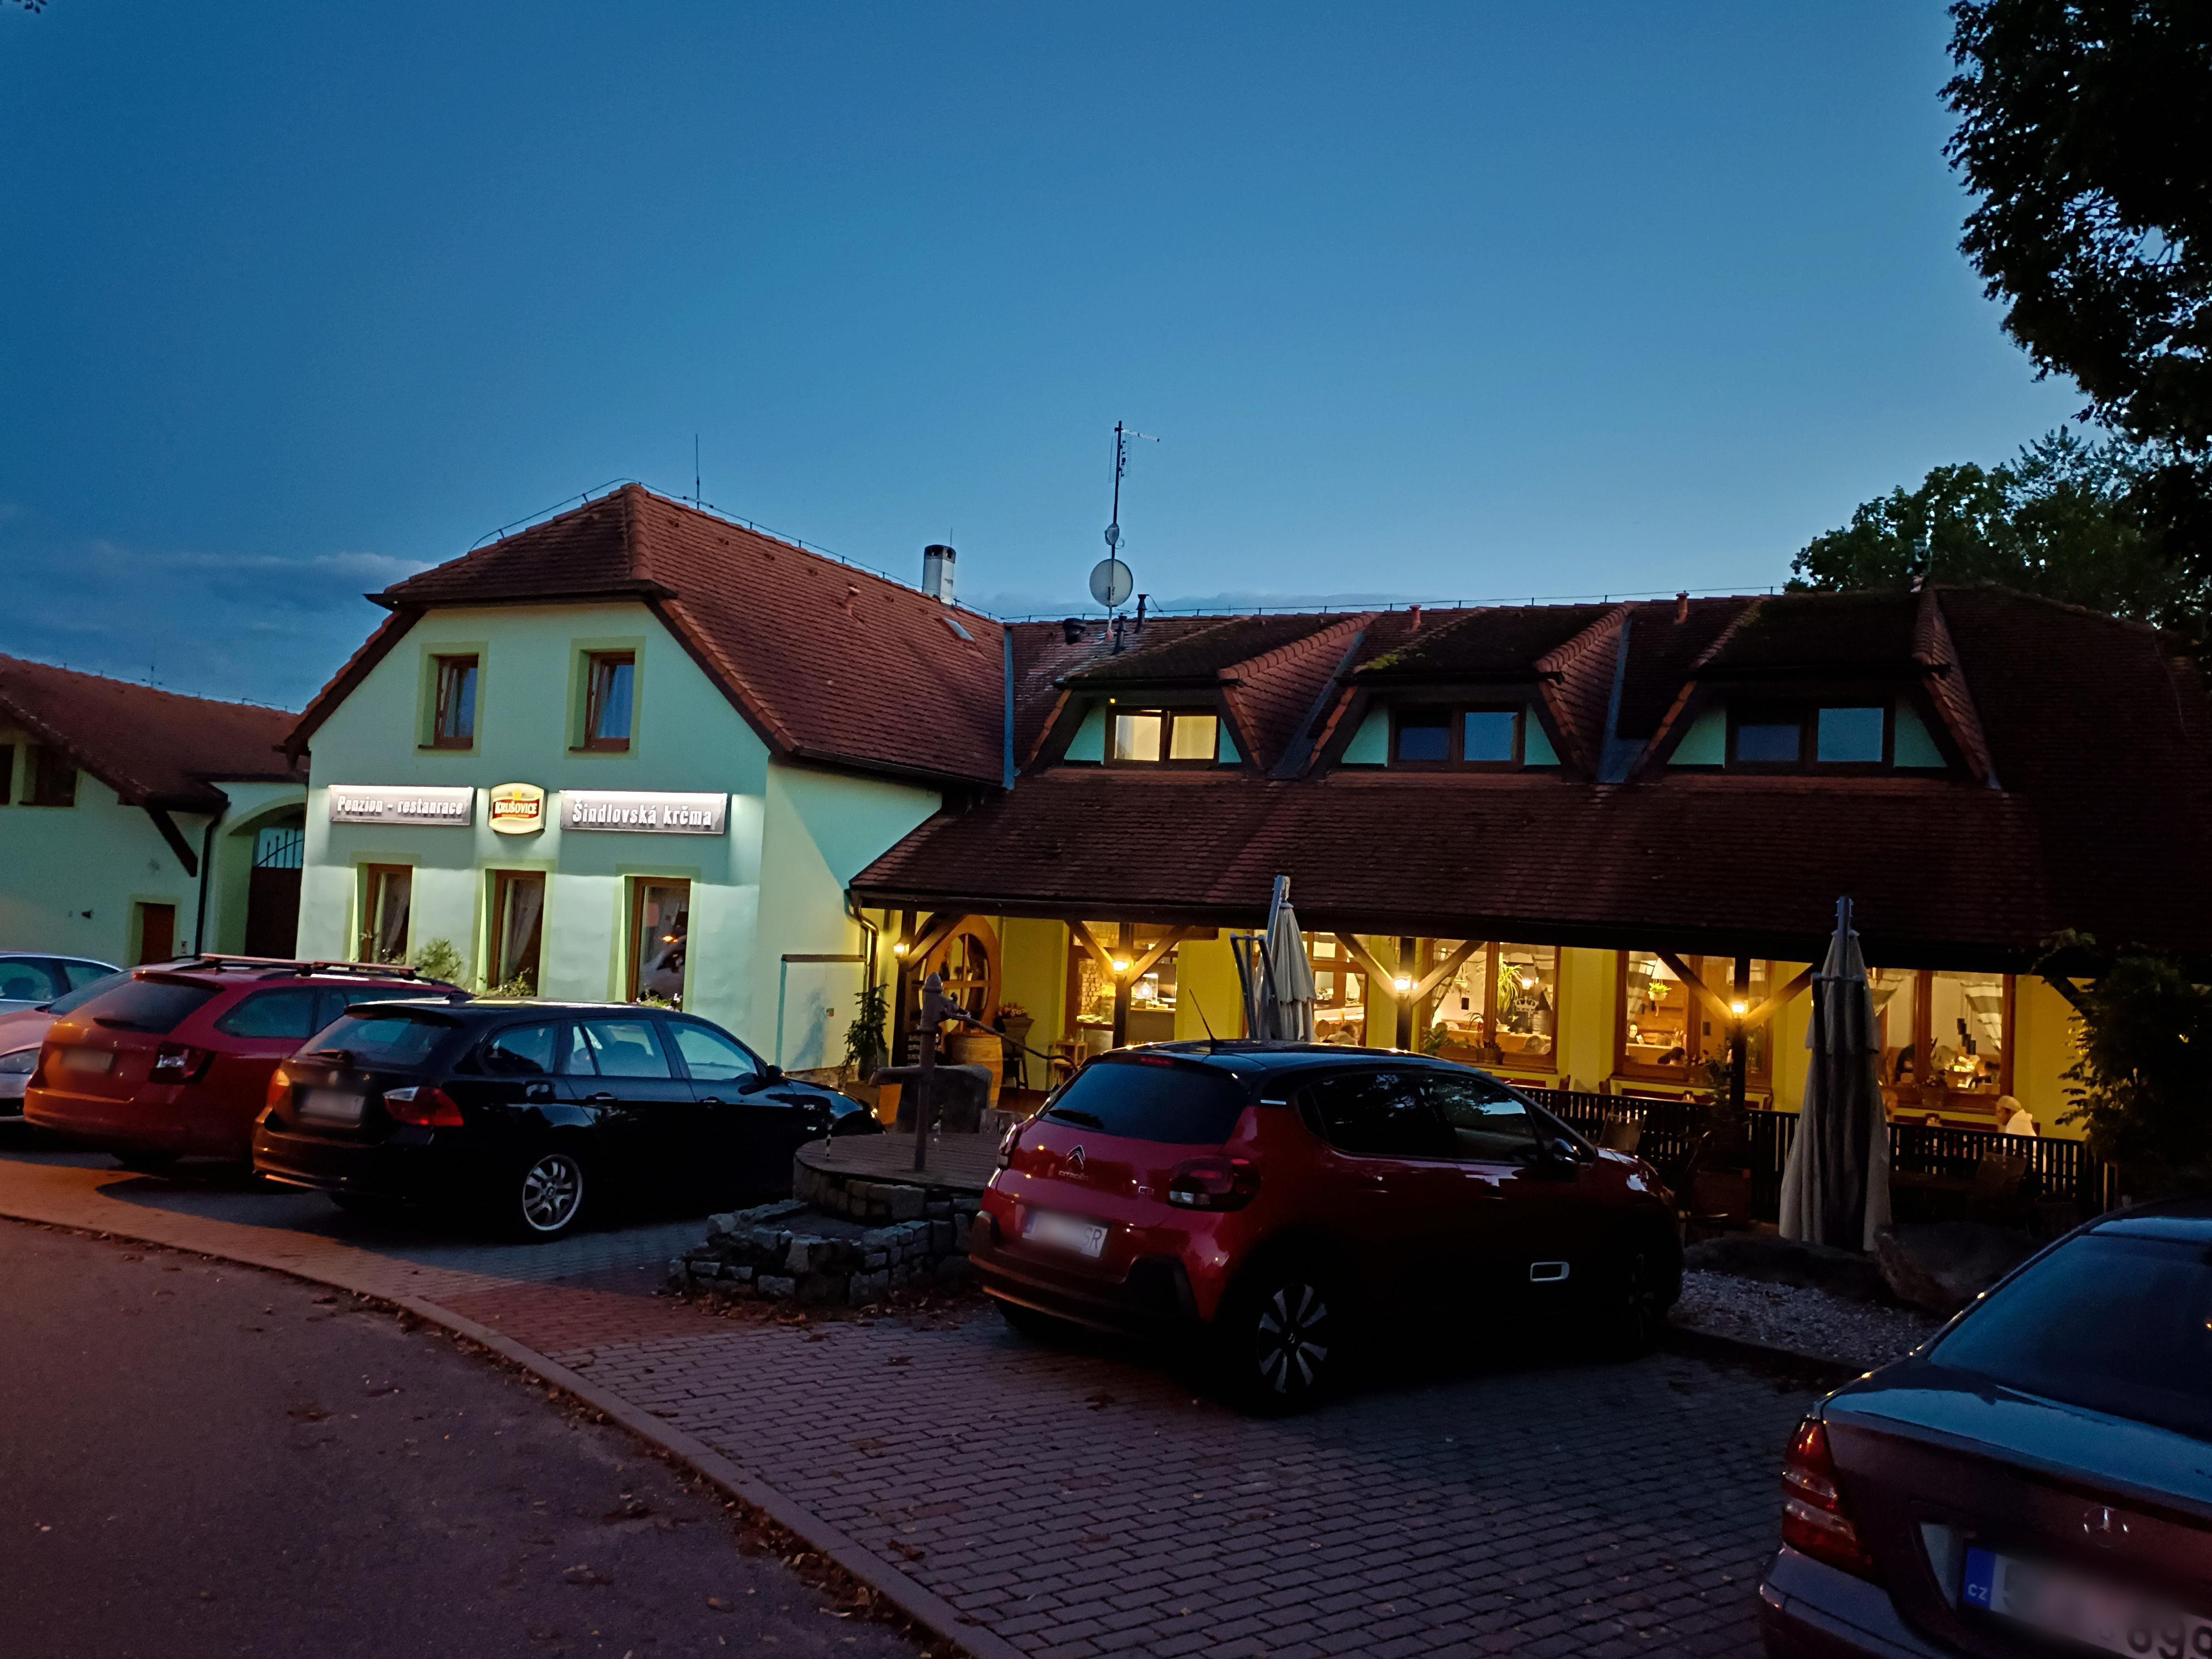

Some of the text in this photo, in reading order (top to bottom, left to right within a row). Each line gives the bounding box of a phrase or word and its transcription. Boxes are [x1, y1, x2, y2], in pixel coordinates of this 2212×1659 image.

[337, 796, 383, 813] Penzion
[397, 797, 463, 815] restaurace
[495, 800, 538, 815] KRUŠOVICE
[572, 799, 712, 826] Šindlovská krčma
[1968, 1584, 1988, 1601] CZ
